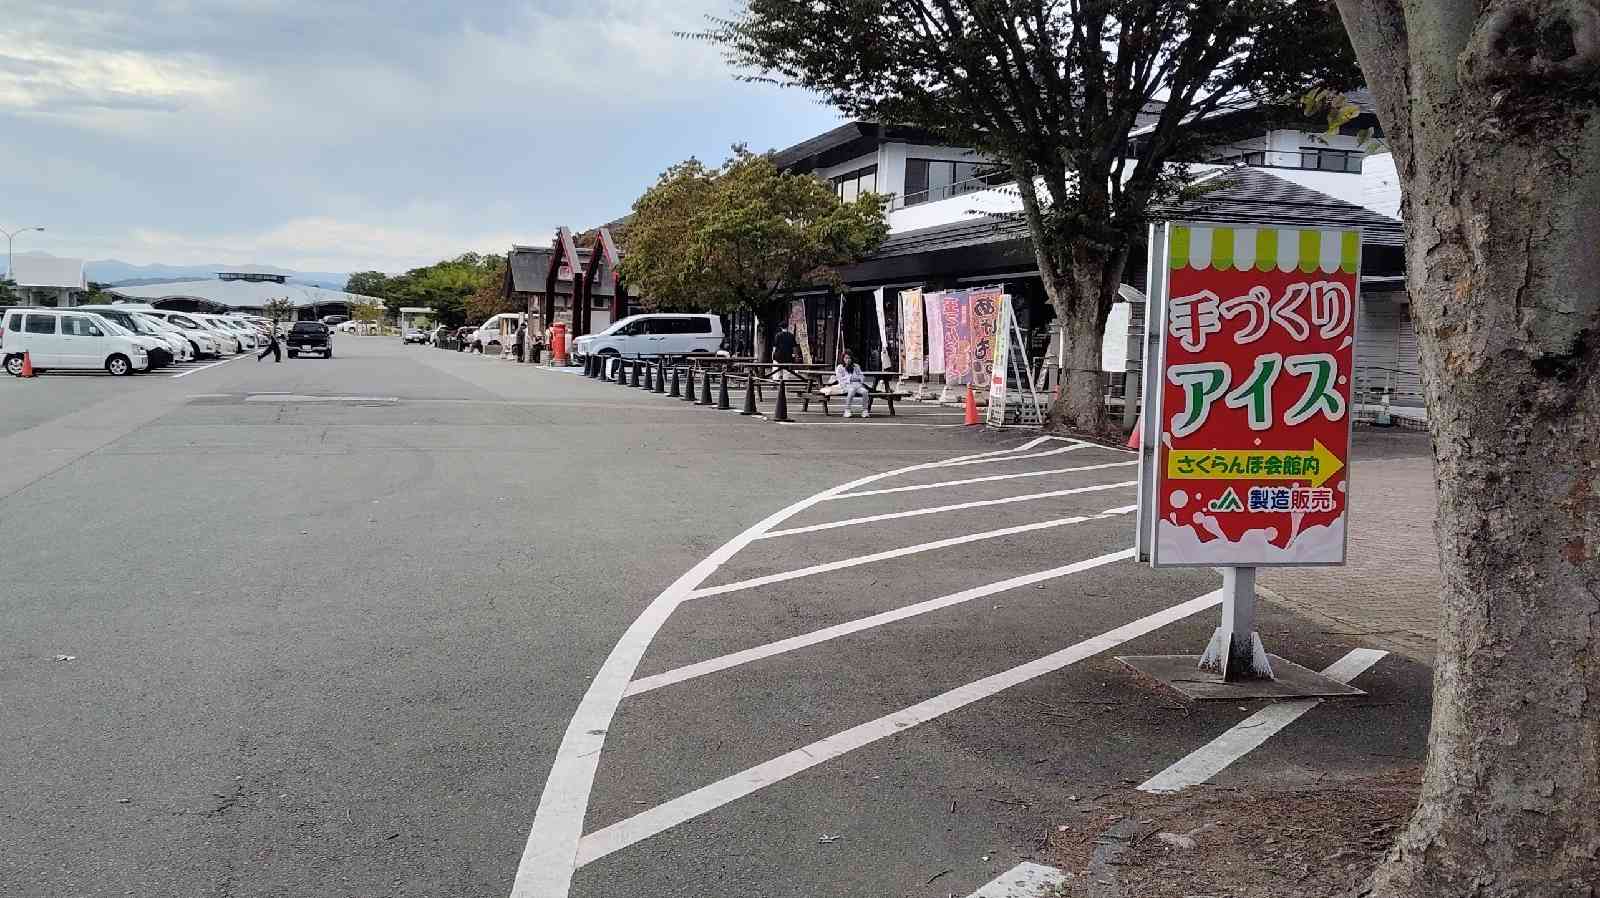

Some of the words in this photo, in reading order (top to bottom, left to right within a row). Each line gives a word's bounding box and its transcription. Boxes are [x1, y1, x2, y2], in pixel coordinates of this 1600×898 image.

[1169, 281, 1352, 352] 手づくり
[1167, 352, 1346, 438] アイス
[1176, 455, 1320, 475] さくらんぼ会館内
[1249, 488, 1332, 511] 製造販売
